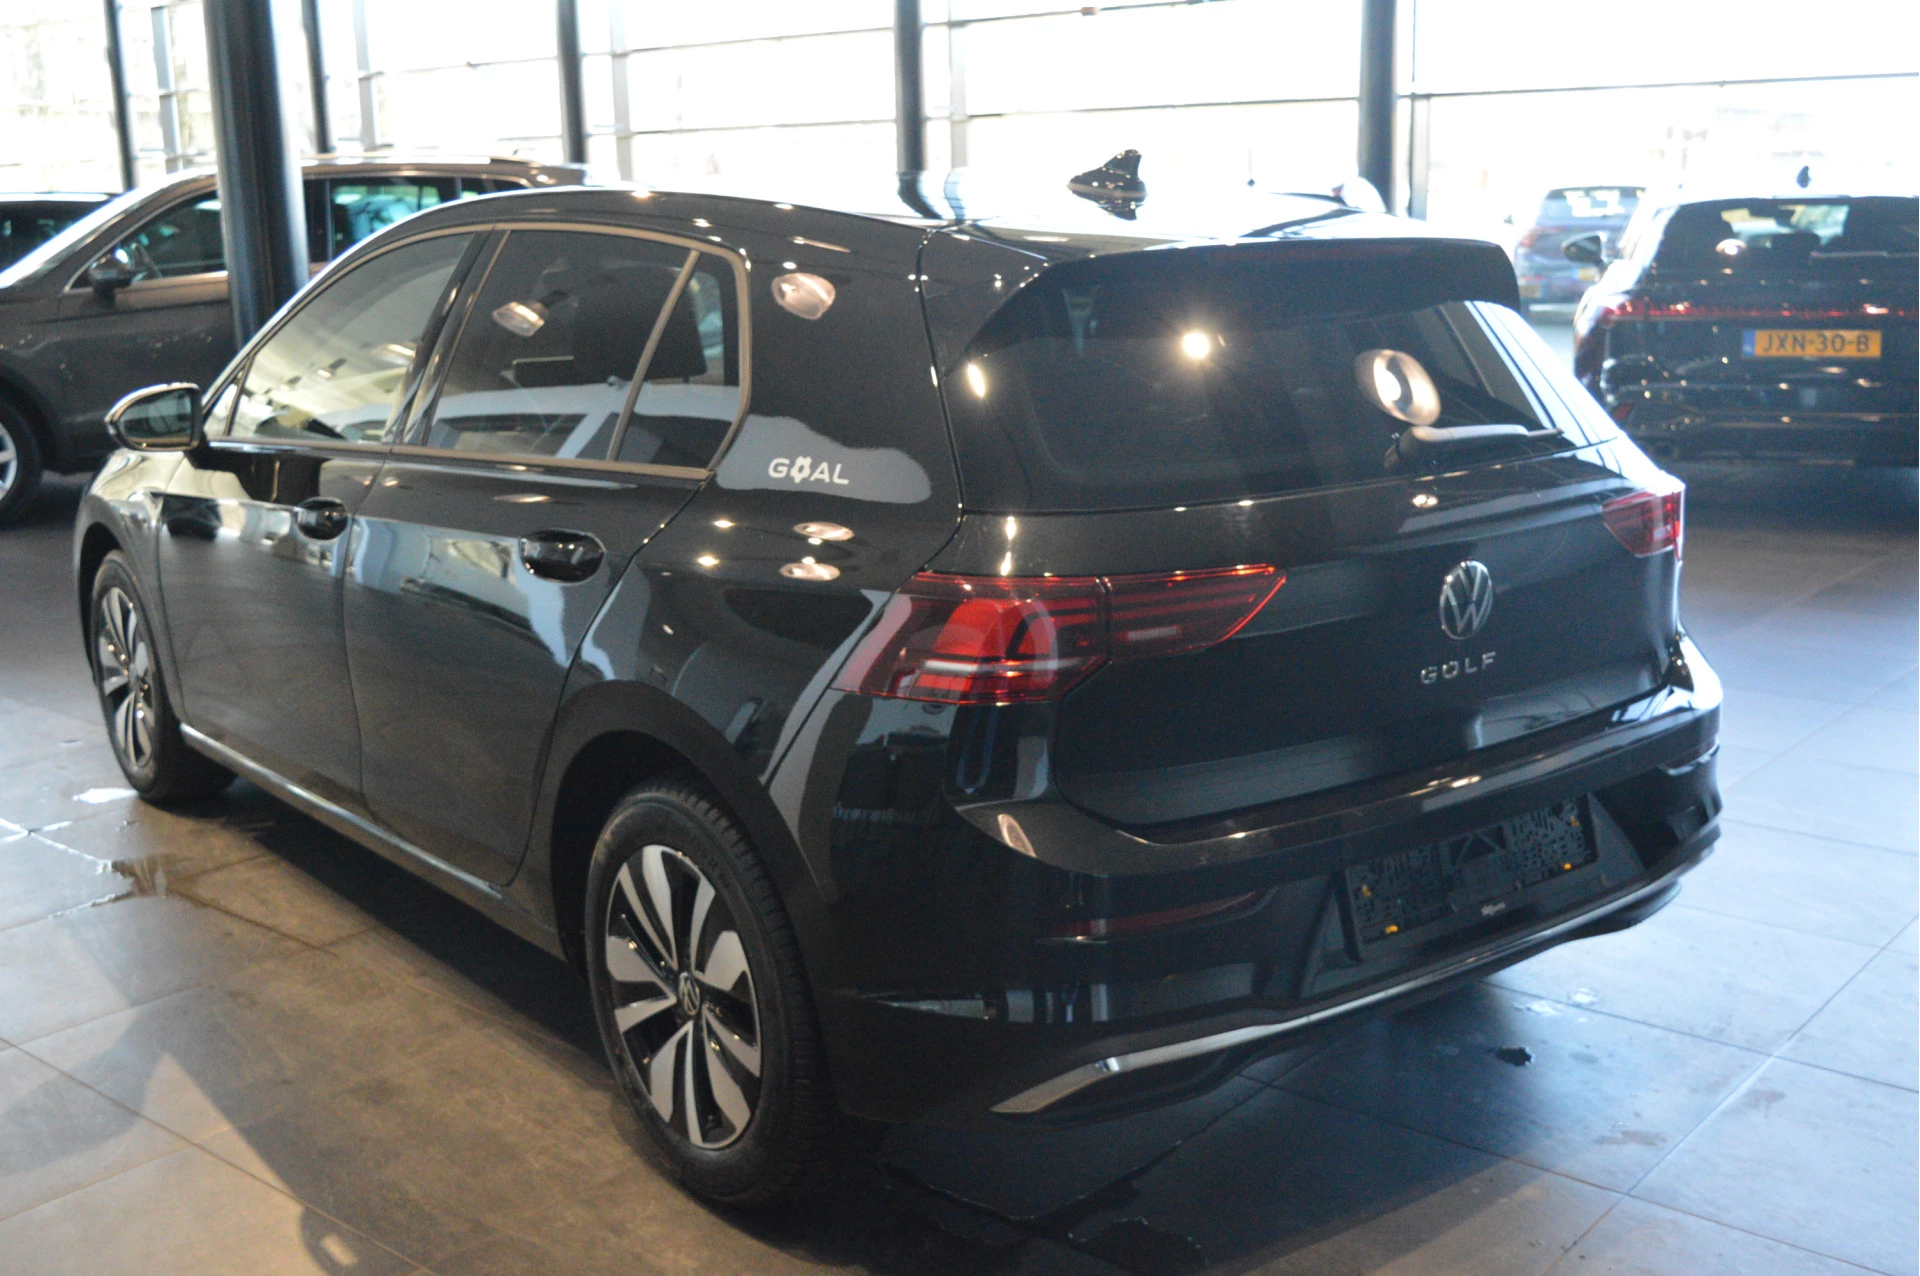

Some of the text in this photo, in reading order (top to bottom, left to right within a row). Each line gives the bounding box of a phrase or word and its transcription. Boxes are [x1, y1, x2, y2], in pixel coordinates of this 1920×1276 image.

[1763, 333, 1870, 353] JXN-30-B
[768, 456, 850, 485] GOAL
[1441, 561, 1492, 638] VW
[1420, 651, 1497, 685] GOLF
